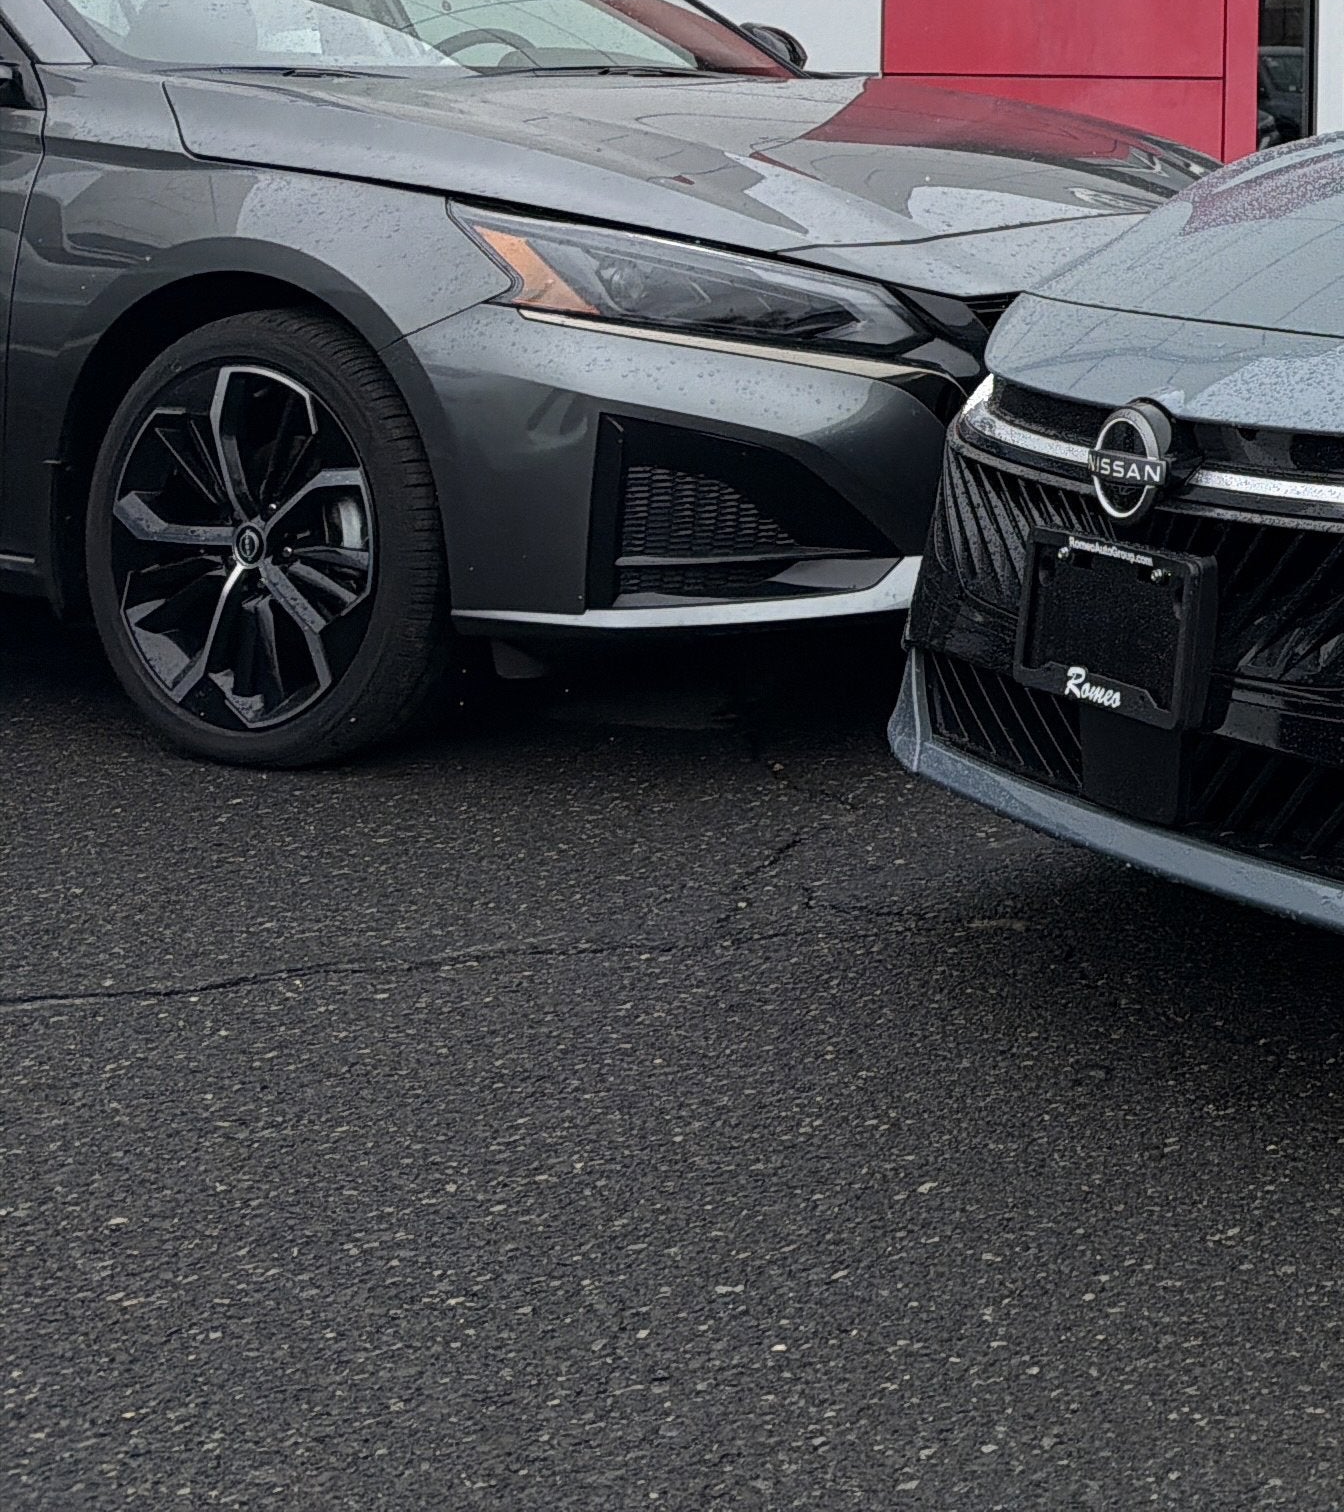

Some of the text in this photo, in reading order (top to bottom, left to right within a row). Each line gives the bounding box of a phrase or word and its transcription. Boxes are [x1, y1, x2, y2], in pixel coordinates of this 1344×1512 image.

[1088, 454, 1161, 483] NISSAN
[1069, 536, 1154, 566] RomeoAutoGroup.com
[1064, 666, 1121, 708] Romeo
